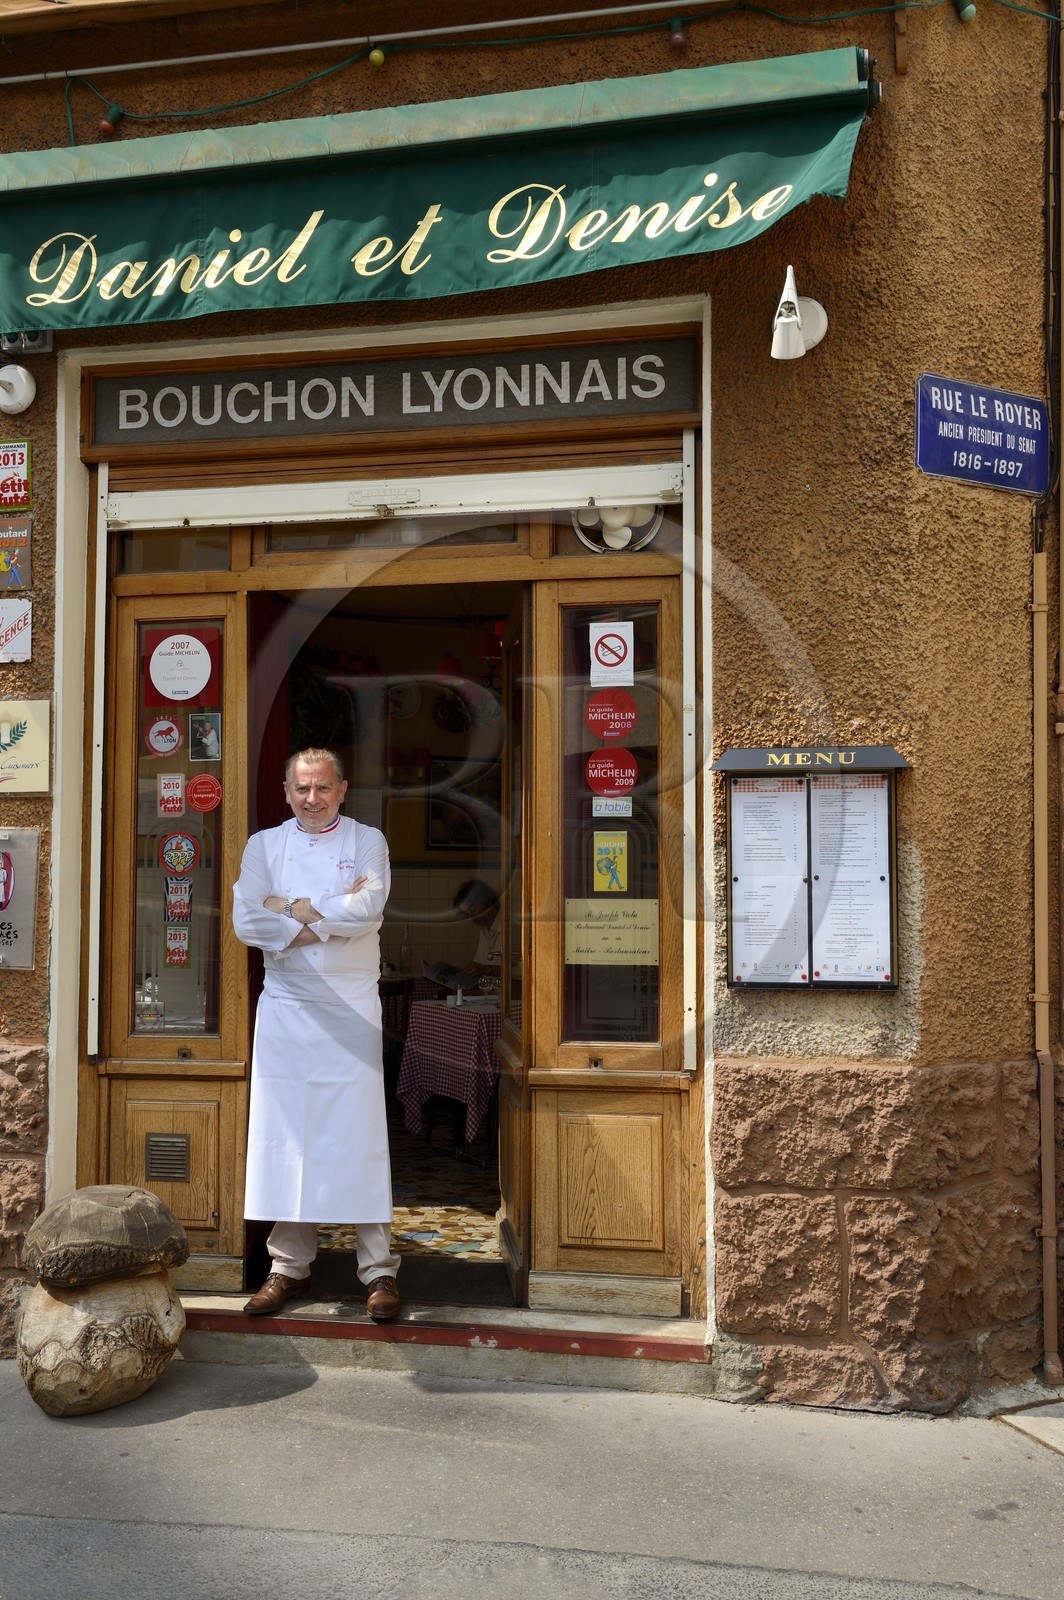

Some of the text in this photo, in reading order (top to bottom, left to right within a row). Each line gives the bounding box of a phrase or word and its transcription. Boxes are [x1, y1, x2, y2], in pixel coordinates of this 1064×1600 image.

[26, 172, 794, 307] Daniel et Denise
[117, 353, 666, 431] BOUCHON LYONNAIS
[931, 386, 1042, 431] RUE LE ROYER
[938, 420, 964, 439] ANCIEN
[1006, 434, 1015, 450] DU
[170, 641, 190, 650] 2007
[588, 712, 635, 720] MICHELIN
[609, 721, 633, 729] 2008
[765, 751, 857, 767] MENU
[596, 762, 614, 770] guide
[588, 769, 635, 778] MICHELIN
[162, 782, 180, 790] 2010
[614, 778, 635, 786] 2009
[604, 801, 631, 812] table
[596, 847, 624, 855] 2011
[169, 886, 187, 895] 2011
[595, 911, 619, 921] Joseph
[168, 932, 187, 941] 2013
